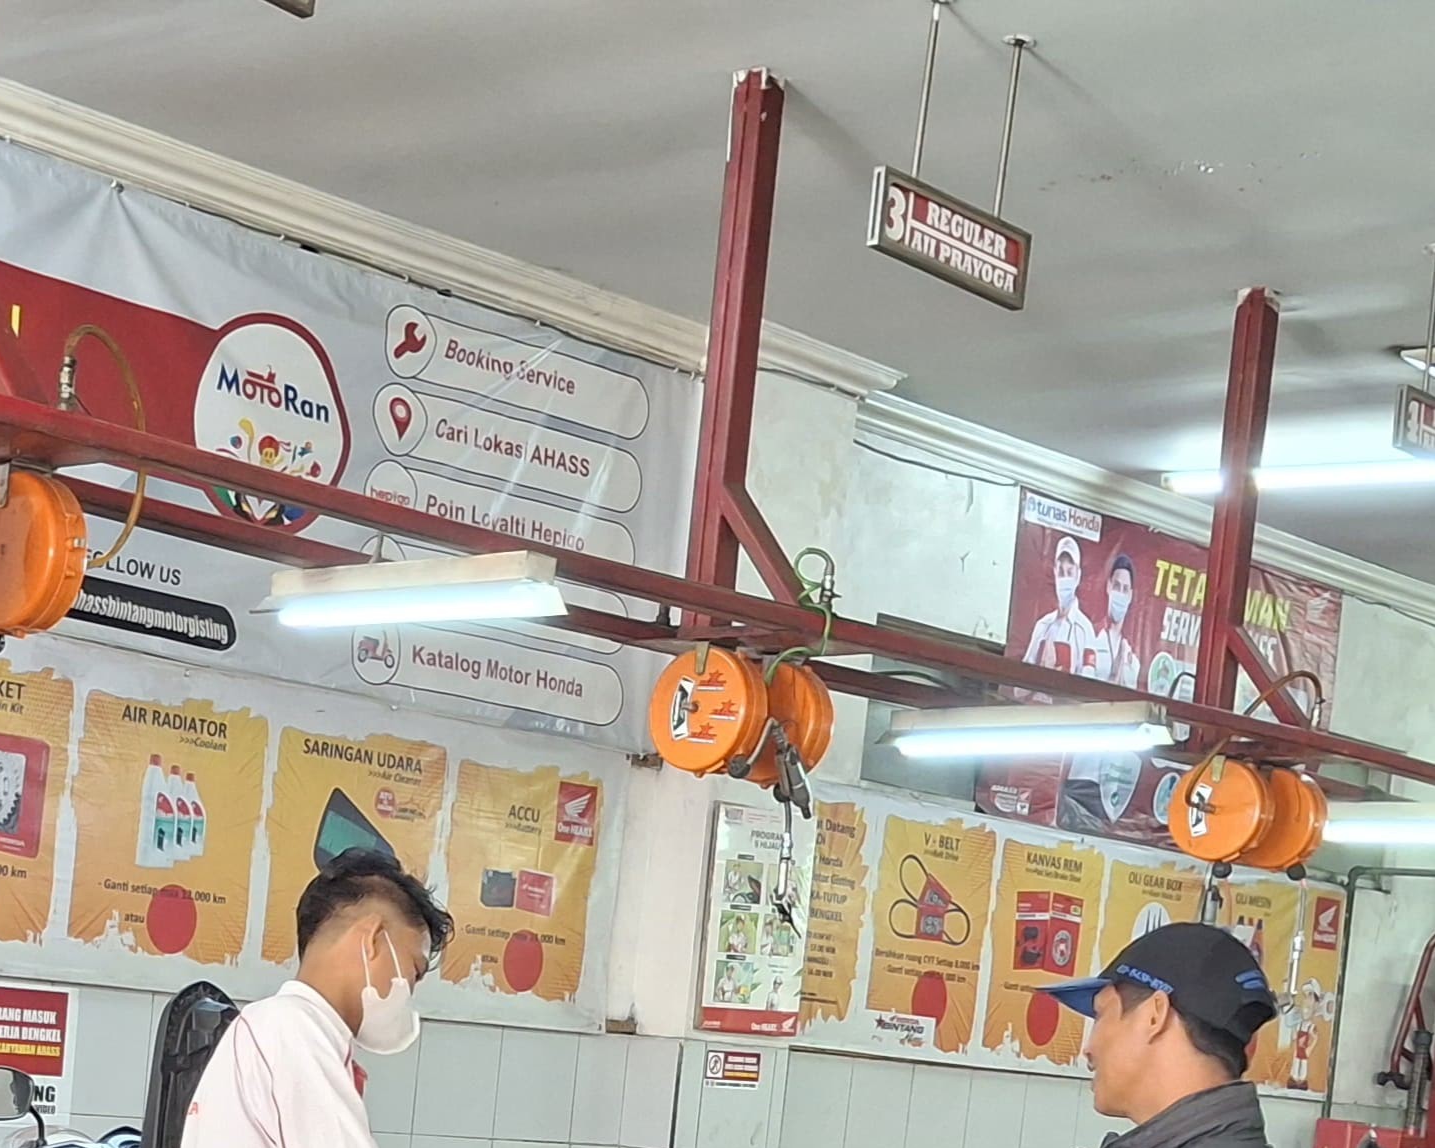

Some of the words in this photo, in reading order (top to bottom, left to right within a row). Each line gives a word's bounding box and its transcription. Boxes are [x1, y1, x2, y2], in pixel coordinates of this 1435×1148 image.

[884, 185, 906, 241] 3
[926, 200, 1007, 260] REGULER
[938, 241, 1015, 293] PRAYOGA
[445, 339, 514, 380] Booking
[517, 360, 576, 395] Service
[435, 419, 469, 445] Cari
[474, 430, 528, 460] Lokasi
[530, 448, 591, 477] AHASS
[426, 495, 465, 521] Poin
[472, 505, 526, 537] Loyalti
[159, 566, 182, 586] US
[1154, 560, 1208, 608] TETA
[1160, 607, 1202, 647] SERV
[412, 647, 482, 681] Katalog
[486, 659, 531, 686] Motor
[535, 671, 584, 697] Honda
[122, 704, 148, 724] AIR
[151, 709, 228, 738] RADIATOR
[303, 738, 373, 767] SARINGAN
[377, 751, 422, 775] UDARA
[508, 805, 541, 823] ACCU
[938, 835, 961, 851] BELT
[11, 864, 28, 878] km
[1026, 851, 1061, 870] KANVAS
[1063, 859, 1083, 873] REM
[103, 878, 129, 892] Ganti
[1143, 874, 1164, 889] GEAR
[124, 913, 145, 923] atau
[22, 1008, 58, 1024] MASUK
[21, 1027, 62, 1042] BENGKEL
